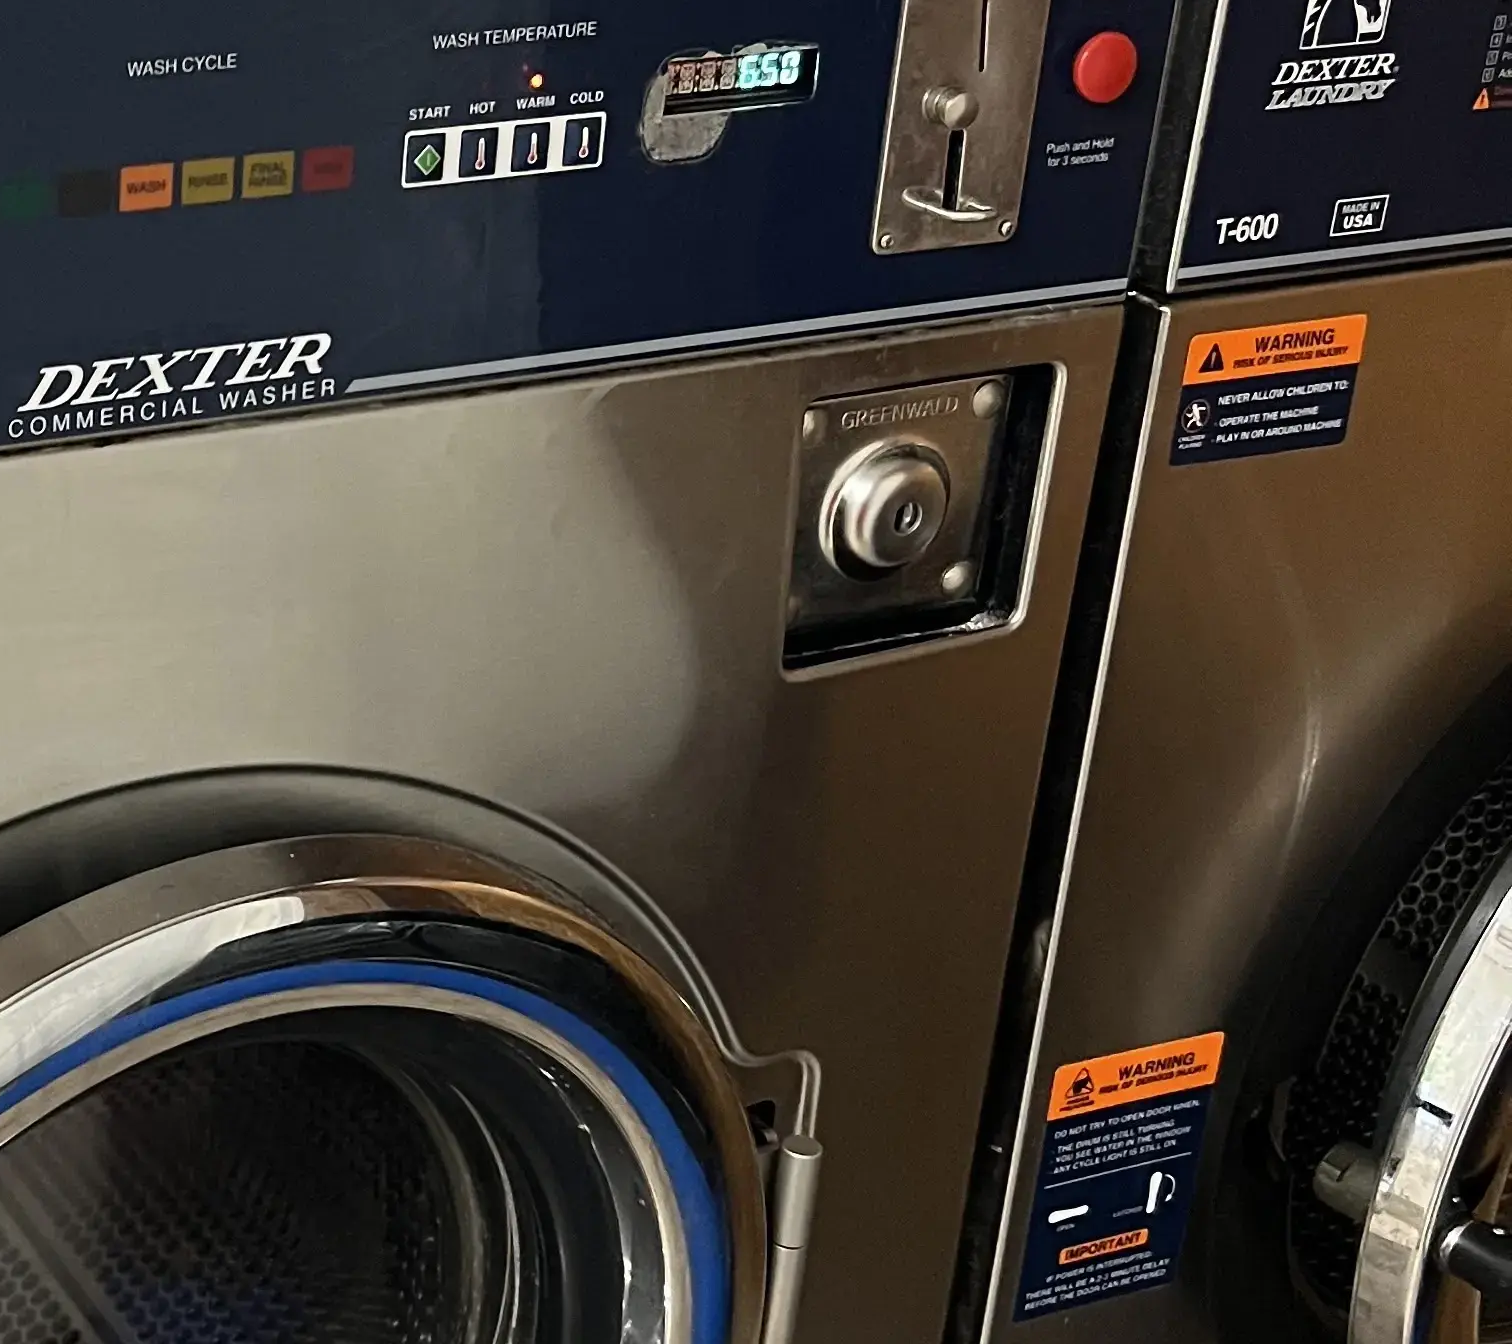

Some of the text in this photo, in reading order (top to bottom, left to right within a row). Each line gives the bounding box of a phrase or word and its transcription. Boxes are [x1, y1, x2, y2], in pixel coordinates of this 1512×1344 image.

[432, 21, 597, 50] WASH TEMPERATURE
[128, 53, 238, 77] WASH CYCLE
[1271, 52, 1395, 85] DEXTER
[516, 94, 556, 110] WARM
[570, 91, 604, 105] COLD
[1265, 79, 1395, 111] LAUNDRY
[409, 105, 451, 121] START
[469, 101, 496, 114] HOT
[1046, 138, 1114, 154] Push and Hold
[1047, 152, 1109, 166] for 3 seconds
[127, 179, 167, 195] WASH
[1342, 201, 1380, 213] MADE IN
[1217, 213, 1279, 244] T-600
[1343, 214, 1374, 229] USA
[1255, 328, 1335, 352] WARNING
[17, 332, 332, 413] DEXTER
[1218, 393, 1250, 406] NEVER
[1251, 389, 1285, 401] ALLOW
[1287, 382, 1333, 396] CHILDREN
[8, 378, 335, 438] COMMERCIAL WASHER
[842, 397, 959, 429] GREENWALD
[1119, 1052, 1195, 1080] WARNING
[1064, 1232, 1141, 1261] IMPORTANT
